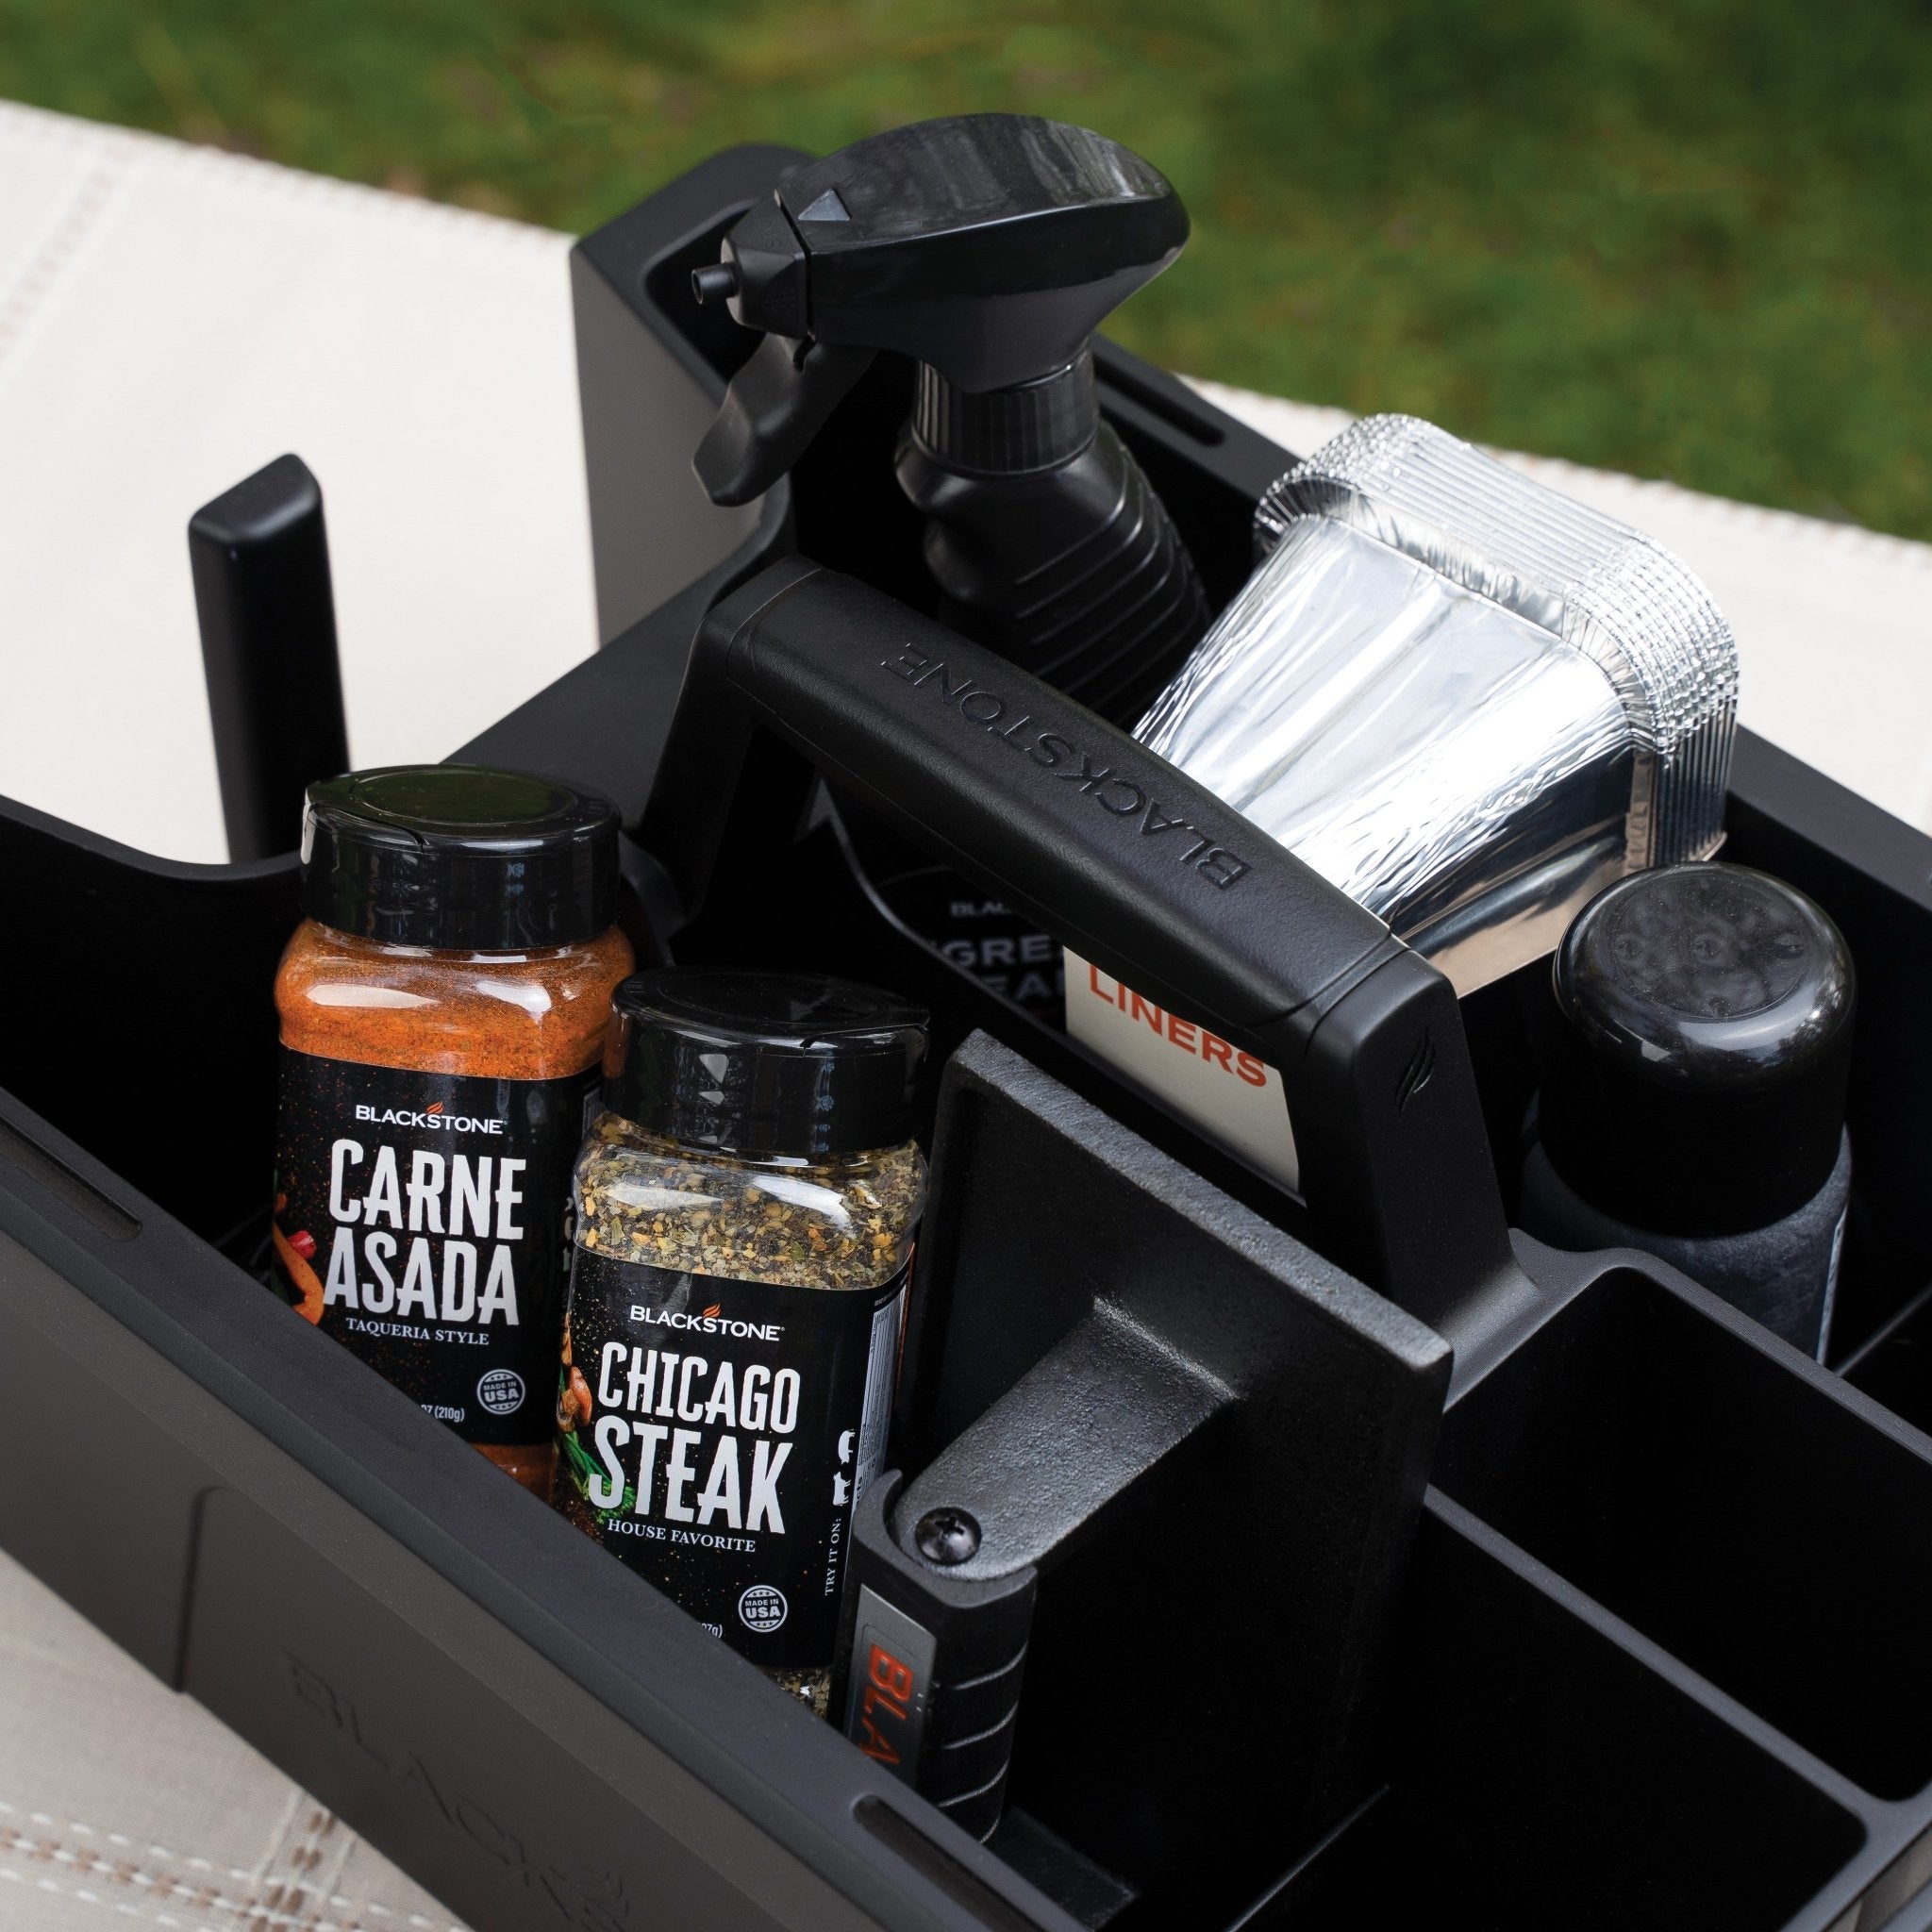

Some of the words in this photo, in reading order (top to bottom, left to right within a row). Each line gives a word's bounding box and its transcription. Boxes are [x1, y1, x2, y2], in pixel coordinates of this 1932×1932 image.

[881, 641, 1255, 891] BLACKSTONE
[941, 934, 1054, 968] GRE
[1090, 964, 1267, 1087] LINERS
[355, 1105, 505, 1135] BLACKSTONE
[329, 1139, 526, 1240] CARNE
[322, 1226, 519, 1326] ASADA
[345, 1317, 431, 1341] TAQUERIA
[435, 1329, 490, 1345] STYLE
[629, 1304, 782, 1342] BLACKSTONE
[484, 1389, 520, 1402] USA
[597, 1341, 801, 1434] CHICAGO
[434, 1405, 465, 1423] (210g)
[588, 1415, 793, 1535] STEAK
[608, 1518, 667, 1541] HOUSE
[671, 1528, 757, 1553] FAVORITE
[830, 1517, 842, 1544] ON:
[827, 1548, 838, 1565] IT
[824, 1567, 836, 1596] TRY
[745, 1606, 781, 1619] USA
